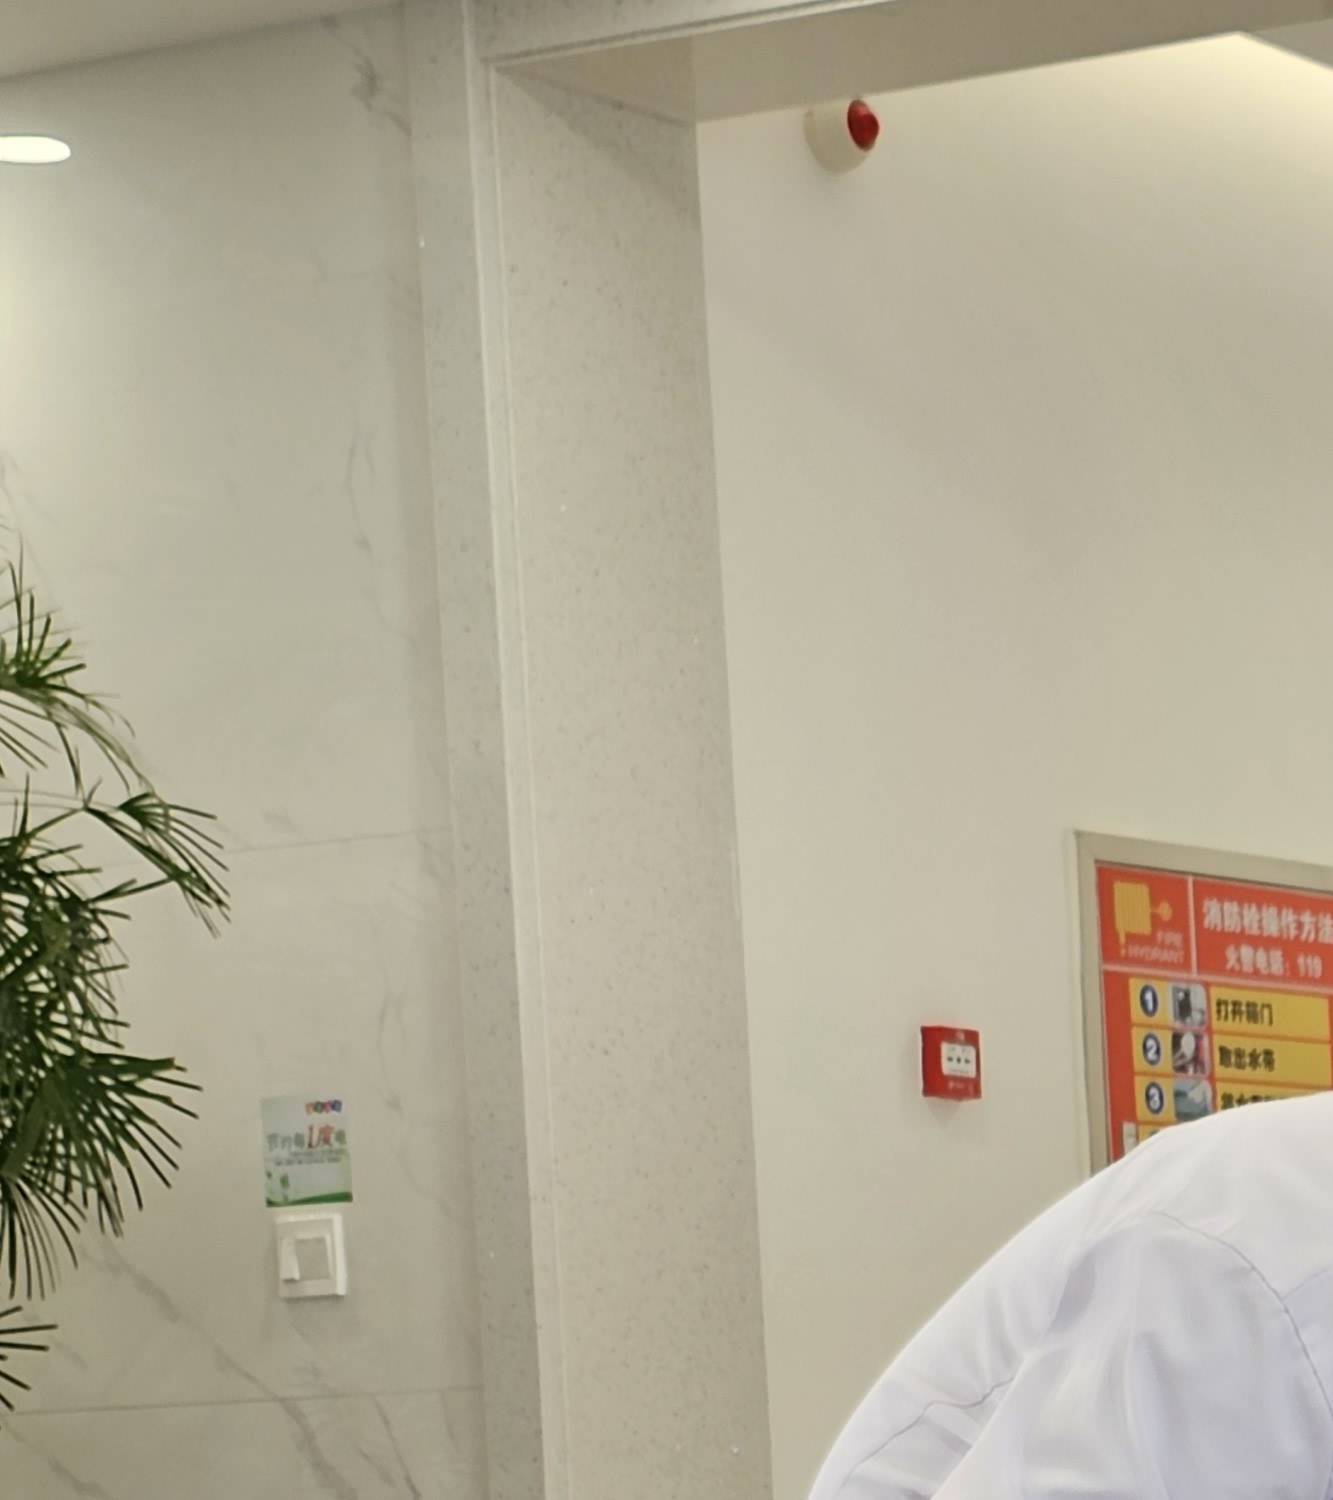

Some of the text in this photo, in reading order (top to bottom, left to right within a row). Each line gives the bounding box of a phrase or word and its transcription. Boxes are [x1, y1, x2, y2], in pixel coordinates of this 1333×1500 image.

[1216, 998, 1274, 1027] 打开箱门
[1146, 1037, 1158, 1062] 2
[1148, 1085, 1161, 1111] 3
